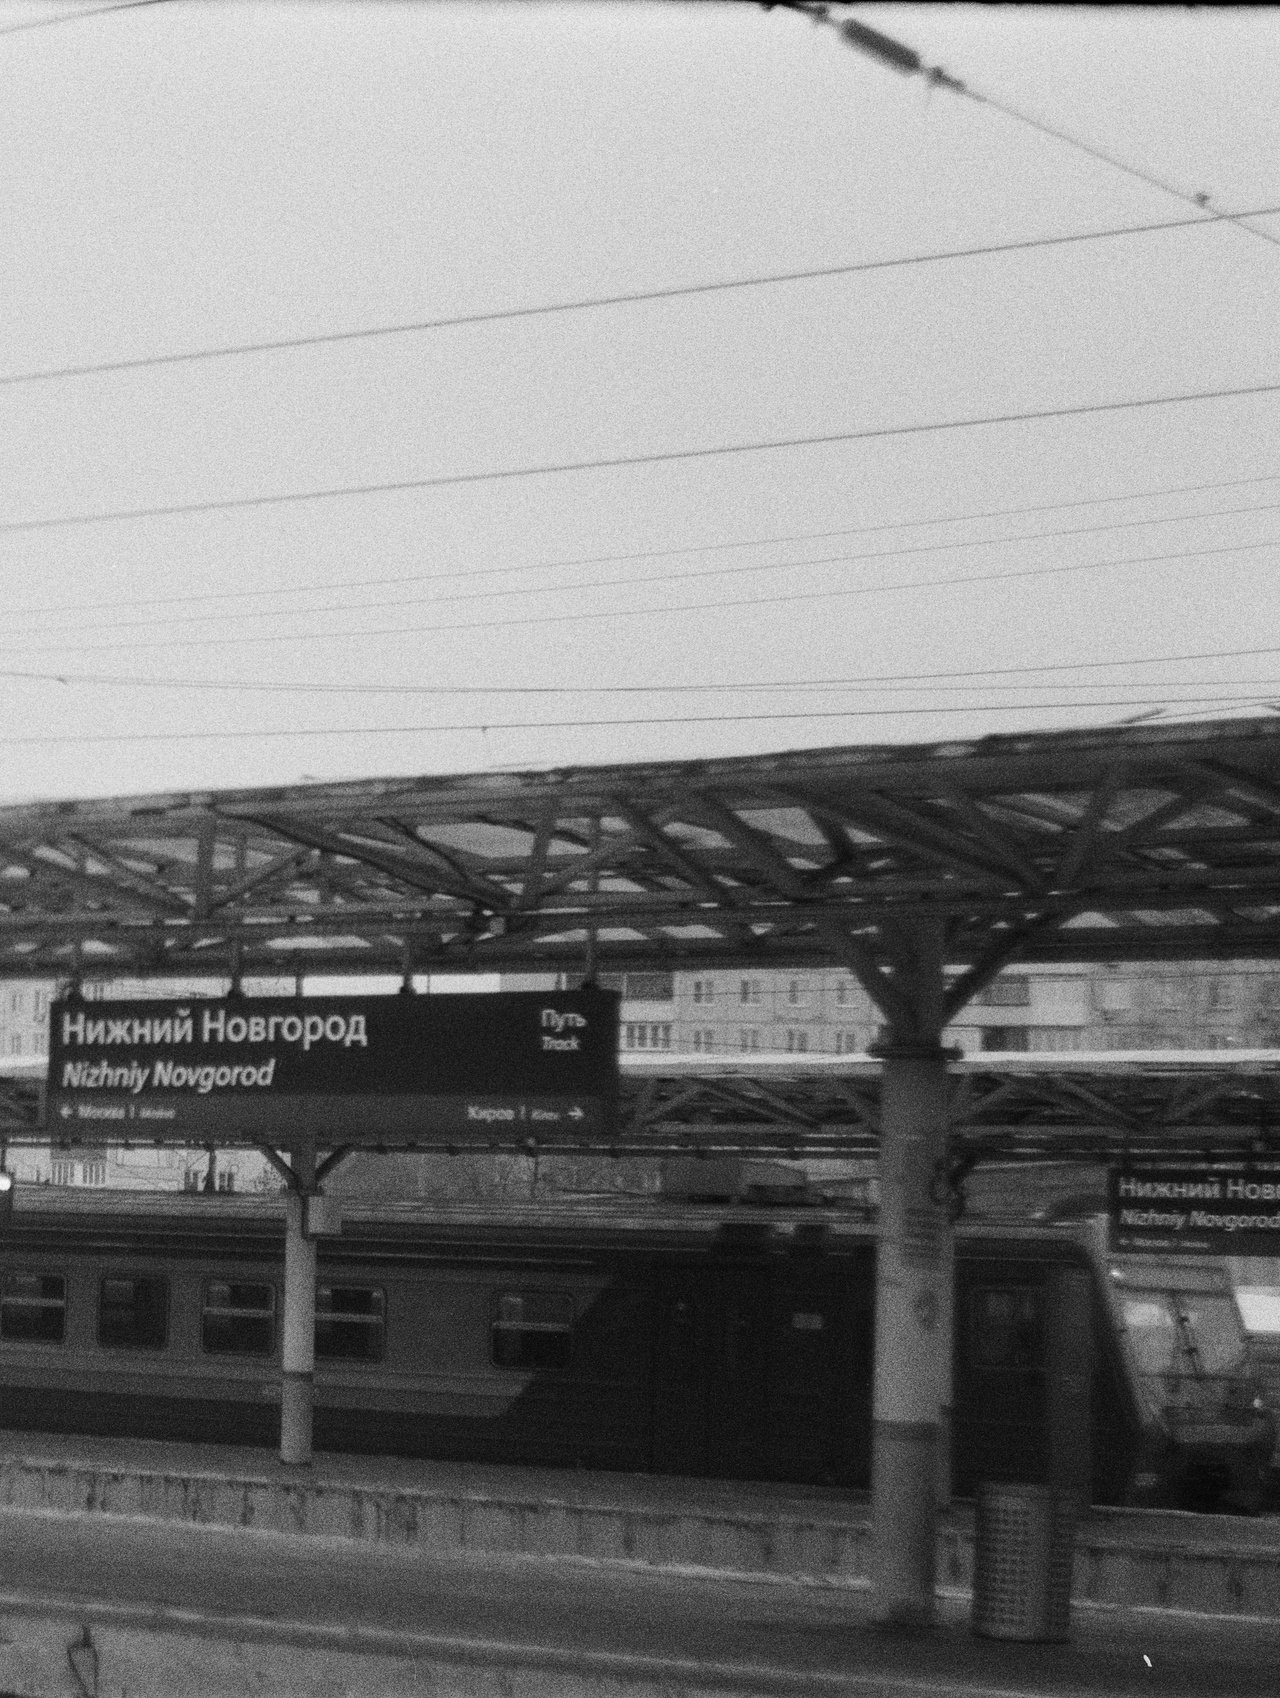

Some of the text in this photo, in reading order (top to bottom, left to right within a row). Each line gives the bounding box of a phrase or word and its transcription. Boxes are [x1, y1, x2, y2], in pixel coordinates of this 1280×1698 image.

[61, 1007, 368, 1051] Нижний Новгород
[540, 1008, 588, 1033] Путь
[541, 1035, 580, 1051] Track
[61, 1057, 277, 1094] Nizhniy Novgorod
[1118, 1176, 1221, 1199] Нижний
[1119, 1208, 1187, 1231] Nizhniy
